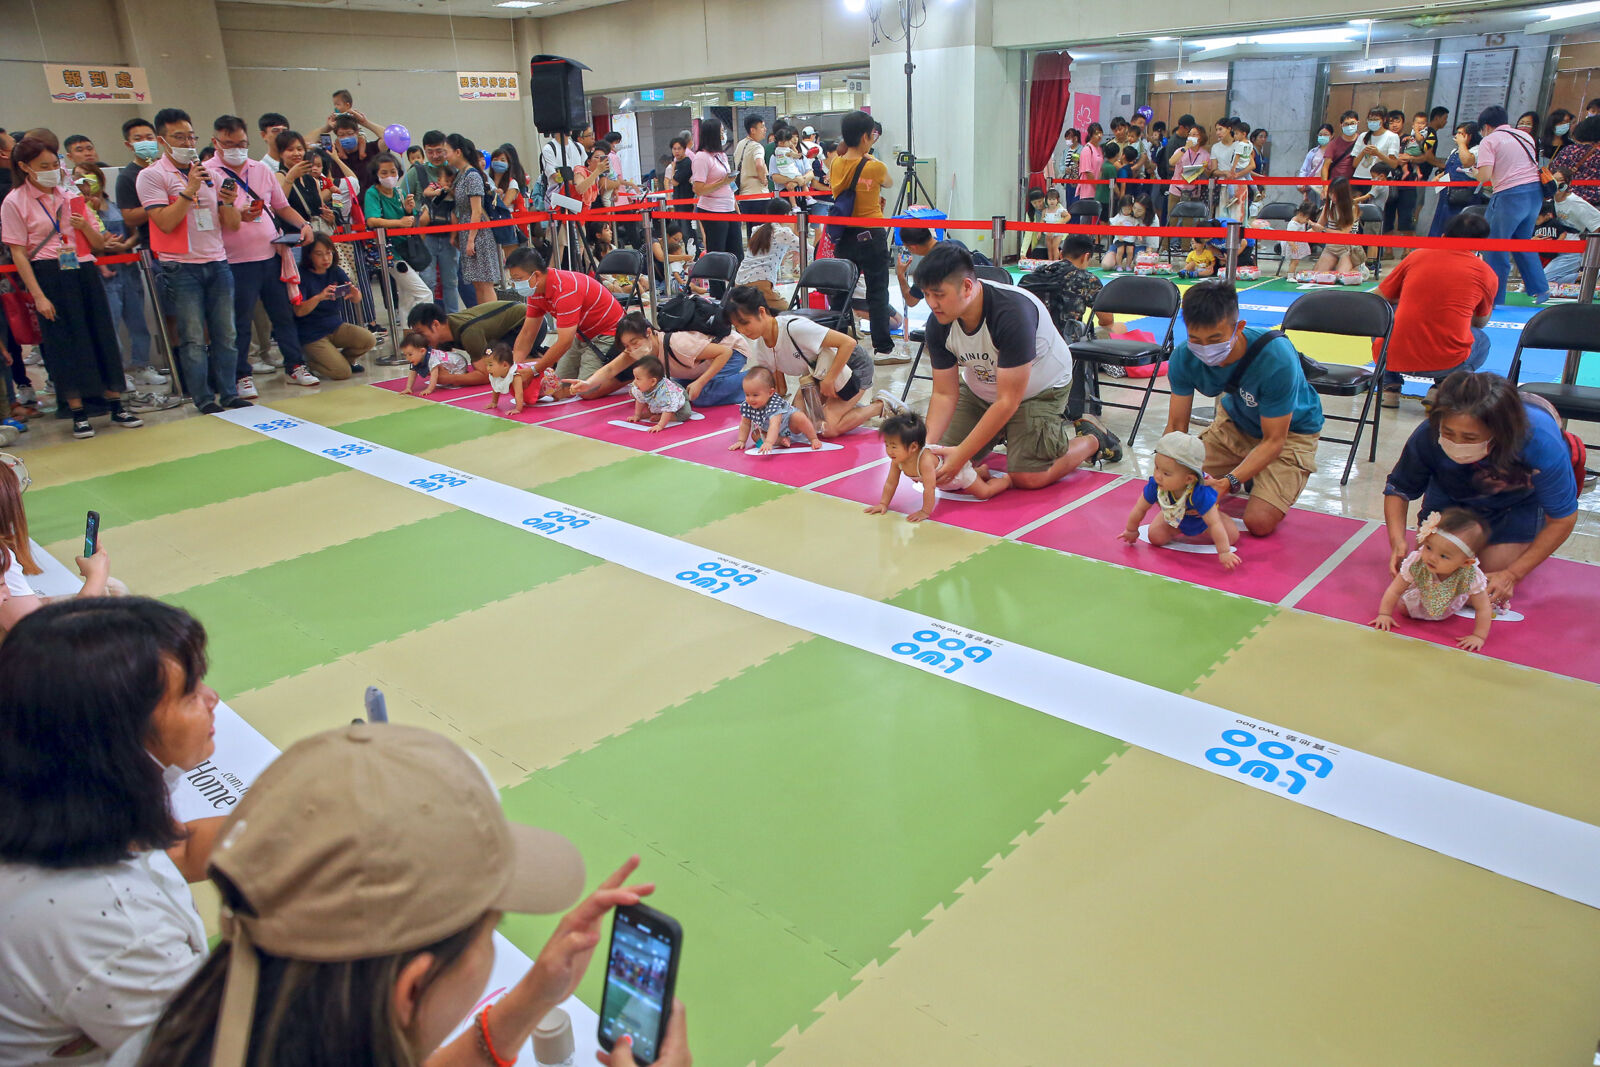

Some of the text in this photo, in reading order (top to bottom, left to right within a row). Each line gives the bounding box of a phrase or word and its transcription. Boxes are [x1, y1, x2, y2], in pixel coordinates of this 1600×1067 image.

[62, 69, 134, 89] 報到處
[676, 570, 730, 594] two
[698, 562, 758, 586] boo
[931, 622, 946, 630] boo
[946, 627, 962, 636] Two
[891, 642, 964, 674] two
[912, 630, 993, 664] boo
[1235, 719, 1256, 729] boo
[1258, 726, 1280, 738] Two
[1221, 729, 1334, 779] boo
[1205, 747, 1306, 795] two
[186, 760, 238, 810] Home
[220, 772, 249, 796] .com.t
